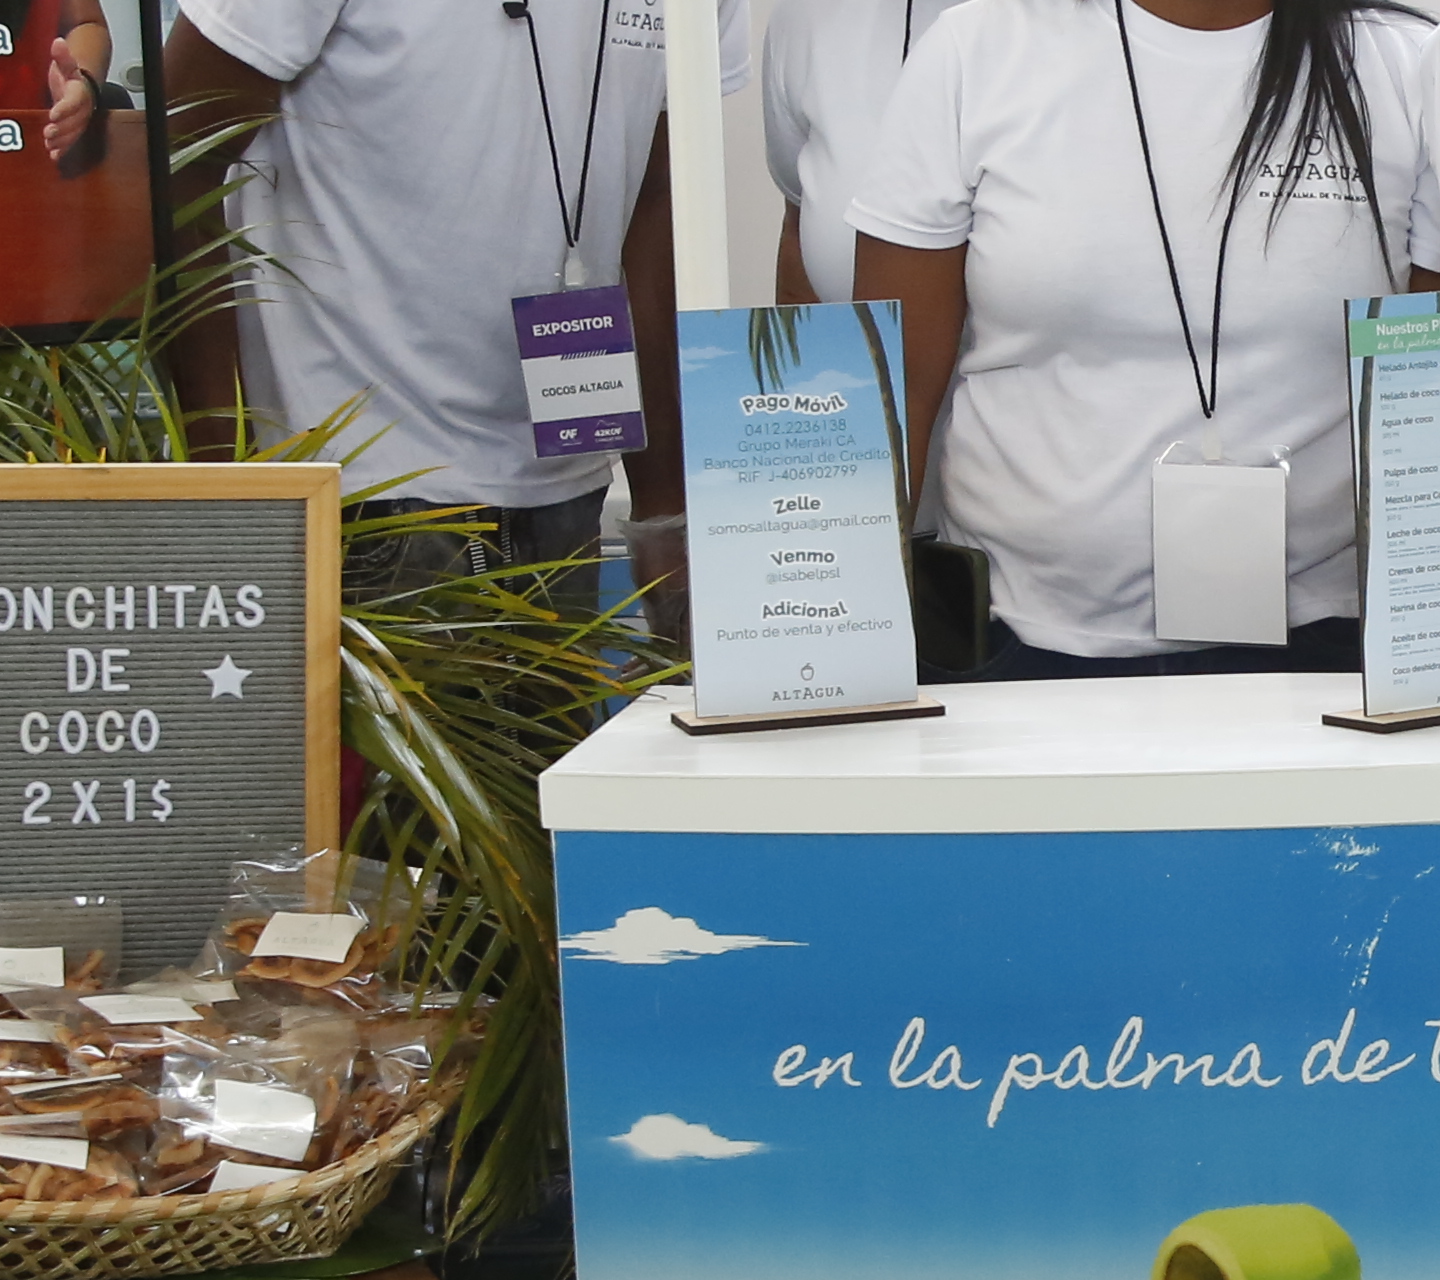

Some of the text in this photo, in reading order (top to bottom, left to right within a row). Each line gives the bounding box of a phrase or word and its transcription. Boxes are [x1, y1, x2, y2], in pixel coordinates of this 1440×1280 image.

[532, 315, 614, 337] EXPOSITOR
[1375, 322, 1429, 336] Nuestros
[1393, 336, 1404, 350] la
[1378, 362, 1406, 372] Helado
[542, 379, 624, 398] COCOS ALTAGUA
[1380, 388, 1440, 401] Helado de coco
[741, 394, 846, 414] Pago Móvil
[744, 419, 847, 437] 0412.2236138
[1381, 414, 1434, 429] Agua de coco
[738, 434, 856, 454] Grupo Meraki CA
[704, 457, 748, 470] Banco
[752, 453, 814, 467] Nacional
[818, 450, 835, 463] de
[738, 464, 858, 484] RIF J-406902799
[1384, 465, 1438, 478] Pulpa de coco
[772, 496, 821, 514] Zelle
[1385, 494, 1413, 505] Mezcla
[1414, 492, 1431, 503] para
[708, 514, 891, 536] somosaltagua@gmail.com
[1387, 529, 1410, 539] Leche
[1412, 527, 1422, 536] de
[770, 550, 836, 566] Venmo
[1388, 567, 1414, 577] Crema
[1416, 565, 1425, 573] de
[762, 601, 849, 619] Adicional
[1390, 603, 1415, 614] Harina
[1417, 601, 1427, 610] de
[717, 618, 893, 642] Punto de venta y efectivo
[1391, 634, 1416, 644] Aceite
[1417, 631, 1427, 640] de
[67, 647, 132, 693] DE
[1392, 666, 1411, 675] Coco
[772, 686, 845, 702] ALTAGUA
[20, 708, 161, 755] COCO
[22, 780, 52, 826] 2
[71, 780, 102, 825] X
[772, 1042, 862, 1090] en
[889, 1016, 980, 1094] la
[989, 1015, 1282, 1128] palma
[1301, 1009, 1417, 1086] de
